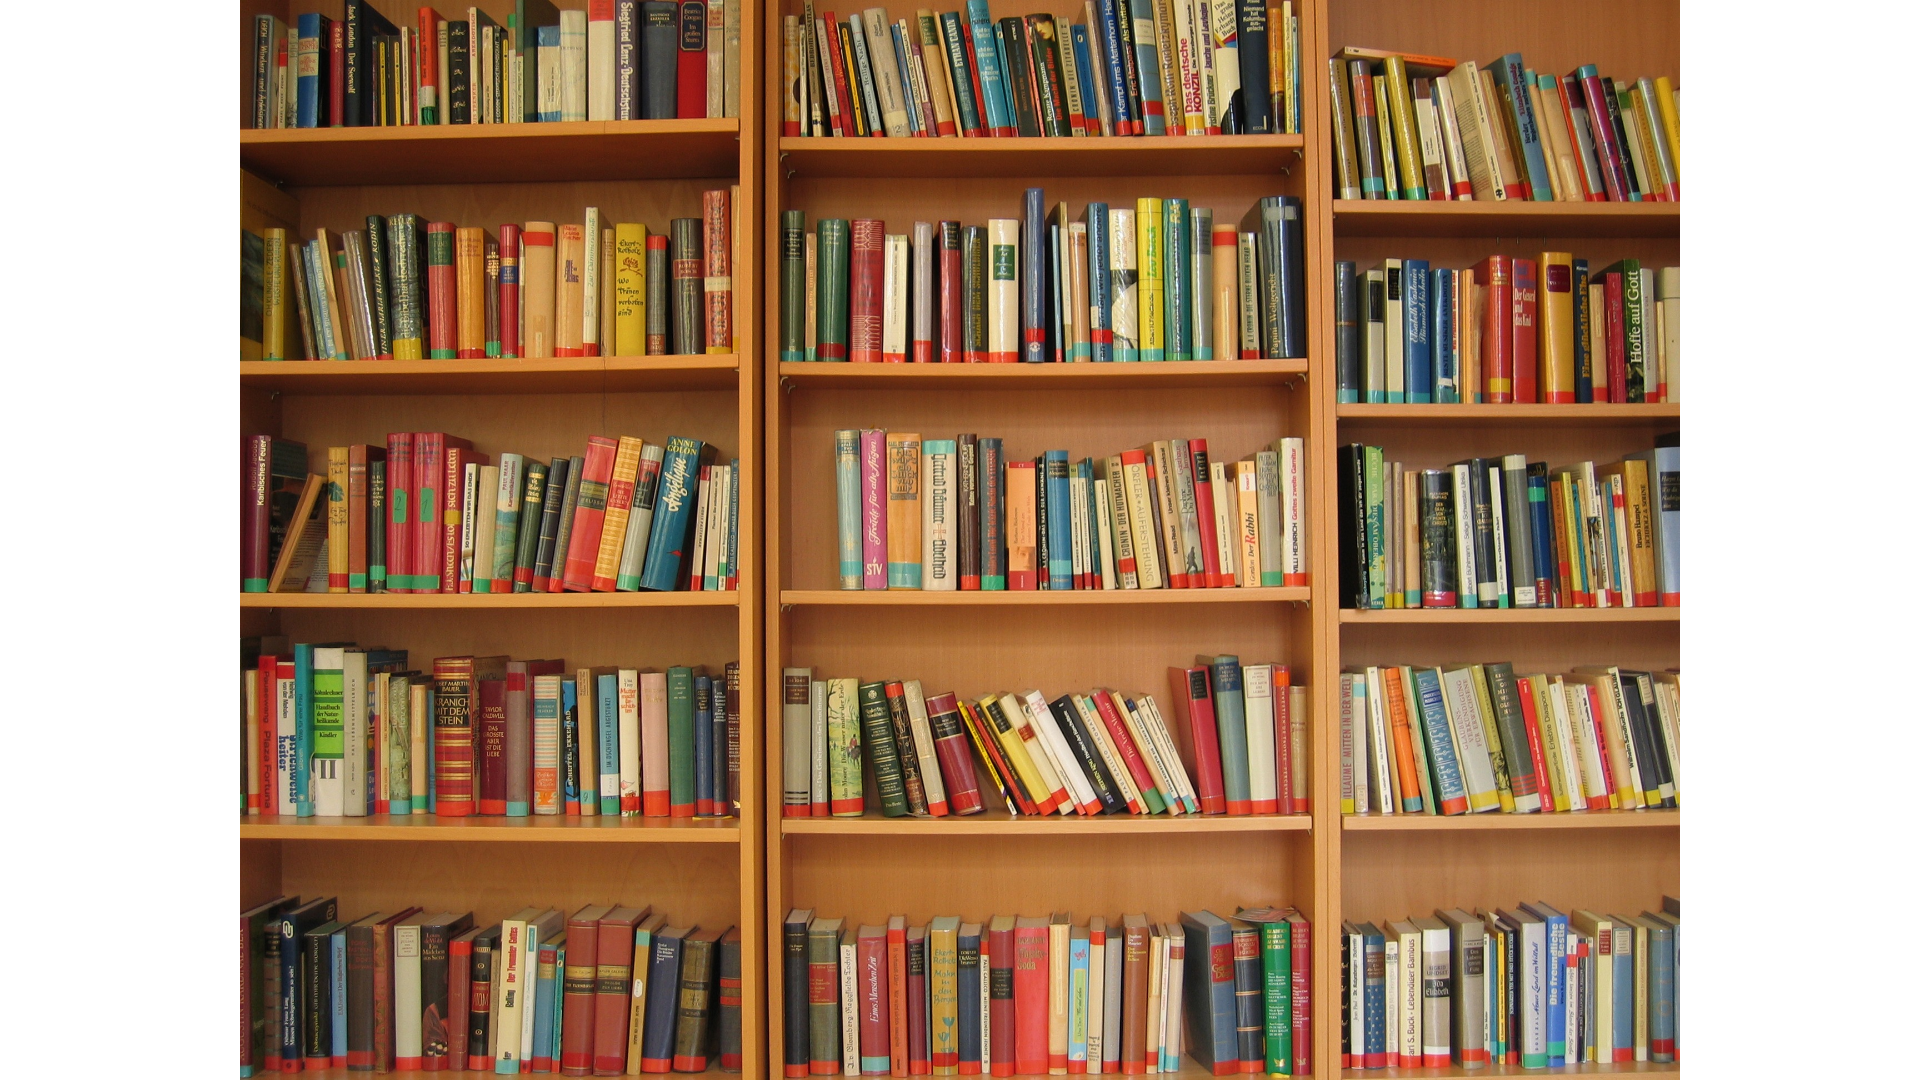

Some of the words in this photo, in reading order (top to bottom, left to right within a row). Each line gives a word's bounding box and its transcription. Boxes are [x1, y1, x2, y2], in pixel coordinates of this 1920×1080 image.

[348, 5, 356, 21] Jack
[1214, 2, 1226, 10] Das
[1218, 11, 1234, 23] Heinz
[1221, 2, 1234, 15] große
[806, 4, 815, 67] BEDROHUNGSATLAS
[946, 19, 958, 42] CANIN
[1215, 18, 1235, 33] Erhardt
[1222, 27, 1235, 37] Buch
[857, 40, 865, 60] Nacht
[1062, 32, 1072, 67] ZITADELLE
[1107, 20, 1120, 64] Matterhorn
[950, 43, 964, 67] ETHAN
[1046, 47, 1055, 69] Bilder
[1180, 39, 1192, 89] deutsche
[347, 67, 355, 93] Seewolf
[859, 61, 870, 86] Heilige
[1040, 62, 1049, 98] Kampmann
[1066, 70, 1075, 80] DIE
[1051, 84, 1060, 106] Macht
[1070, 85, 1079, 112] CRONIN
[1114, 85, 1126, 113] Kampf
[1185, 92, 1194, 113] Das
[1193, 71, 1202, 112] KONZIL
[1514, 86, 1525, 116] Elizabeth
[1045, 100, 1053, 121] Renate
[1055, 108, 1063, 120] Die
[1523, 123, 1531, 143] Herder
[370, 223, 378, 253] RODIN
[374, 266, 382, 294] RILKE
[618, 278, 630, 286] Wo
[618, 287, 640, 296] Tränen
[1579, 275, 1587, 295] Ehe
[1627, 271, 1639, 301] Gott
[618, 299, 644, 307] verboten
[972, 291, 981, 311] DEM
[1267, 273, 1279, 322] Weltgericht
[377, 298, 386, 325] MARIA
[617, 308, 633, 317] sind
[1418, 303, 1427, 344] Stürmisch
[1580, 296, 1590, 351] glückliche
[1628, 302, 1641, 324] auf
[973, 313, 982, 347] SCHACH
[1410, 307, 1418, 343] Elisabeth
[1269, 327, 1279, 354] Papini
[1630, 327, 1642, 363] Hoffe
[1582, 353, 1590, 378] Eine
[258, 440, 267, 462] Feuer
[667, 445, 697, 455] GOLON
[670, 436, 694, 447] ANNE
[868, 438, 880, 473] Augen
[1160, 447, 1169, 474] Schicksal
[257, 463, 266, 506] Karibisches
[662, 457, 687, 512] Angélique
[869, 474, 878, 489] alte
[1112, 470, 1126, 510] HUTMACHER
[1163, 475, 1172, 497] kleines
[868, 491, 881, 507] für
[1166, 498, 1174, 514] Unser
[867, 510, 882, 546] Freude
[1117, 512, 1127, 524] DER
[1244, 512, 1256, 544] Rabbi
[1633, 504, 1642, 528] Hampel
[1119, 530, 1131, 557] CRONIN
[1135, 505, 1154, 582] AUFERSTEHUNG
[1170, 525, 1178, 540] Read
[1291, 523, 1299, 556] HEINRICH
[1635, 529, 1643, 548] Bruno
[1247, 545, 1255, 557] Der
[866, 564, 883, 576] STV
[1248, 559, 1257, 581] Gordon
[1342, 678, 1351, 697] WELT
[1612, 672, 1621, 697] GLAUBE
[449, 707, 470, 716] DEM
[1103, 701, 1119, 725] Mostar
[1342, 700, 1351, 714] DER
[1456, 680, 1474, 742] VERKÜNDIGUNG
[1463, 678, 1479, 729] ERWACHSENE
[1540, 691, 1551, 722] Diaspora
[438, 716, 464, 725] STEIN
[1342, 718, 1351, 726] IN
[1455, 707, 1469, 750] GLAUBENS-
[1620, 711, 1629, 743] Sandfuchs
[264, 731, 272, 762] Plaza
[1116, 725, 1131, 745] Arche
[1342, 729, 1351, 757] MITTEN
[1473, 732, 1482, 747] FÜR
[1546, 724, 1556, 750] Erlebte
[279, 735, 288, 772] heiter
[1128, 746, 1136, 758] Die
[1625, 744, 1634, 768] Wilhelm
[264, 764, 272, 809] Fortuna
[841, 766, 849, 786] Moore
[508, 927, 518, 944] Gottes
[507, 946, 517, 971] Trommler
[869, 956, 877, 970] Zeit
[1407, 939, 1415, 968] Bambus
[1549, 923, 1558, 986] freundliche
[507, 973, 516, 983] Der
[934, 970, 955, 978] Mohn
[868, 971, 879, 1003] Menschen
[1407, 970, 1415, 1010] Lebendiger
[1549, 988, 1558, 1005] Die
[933, 995, 956, 1005] Bergen
[869, 1003, 880, 1022] Eines
[1408, 1035, 1414, 1043] S.
